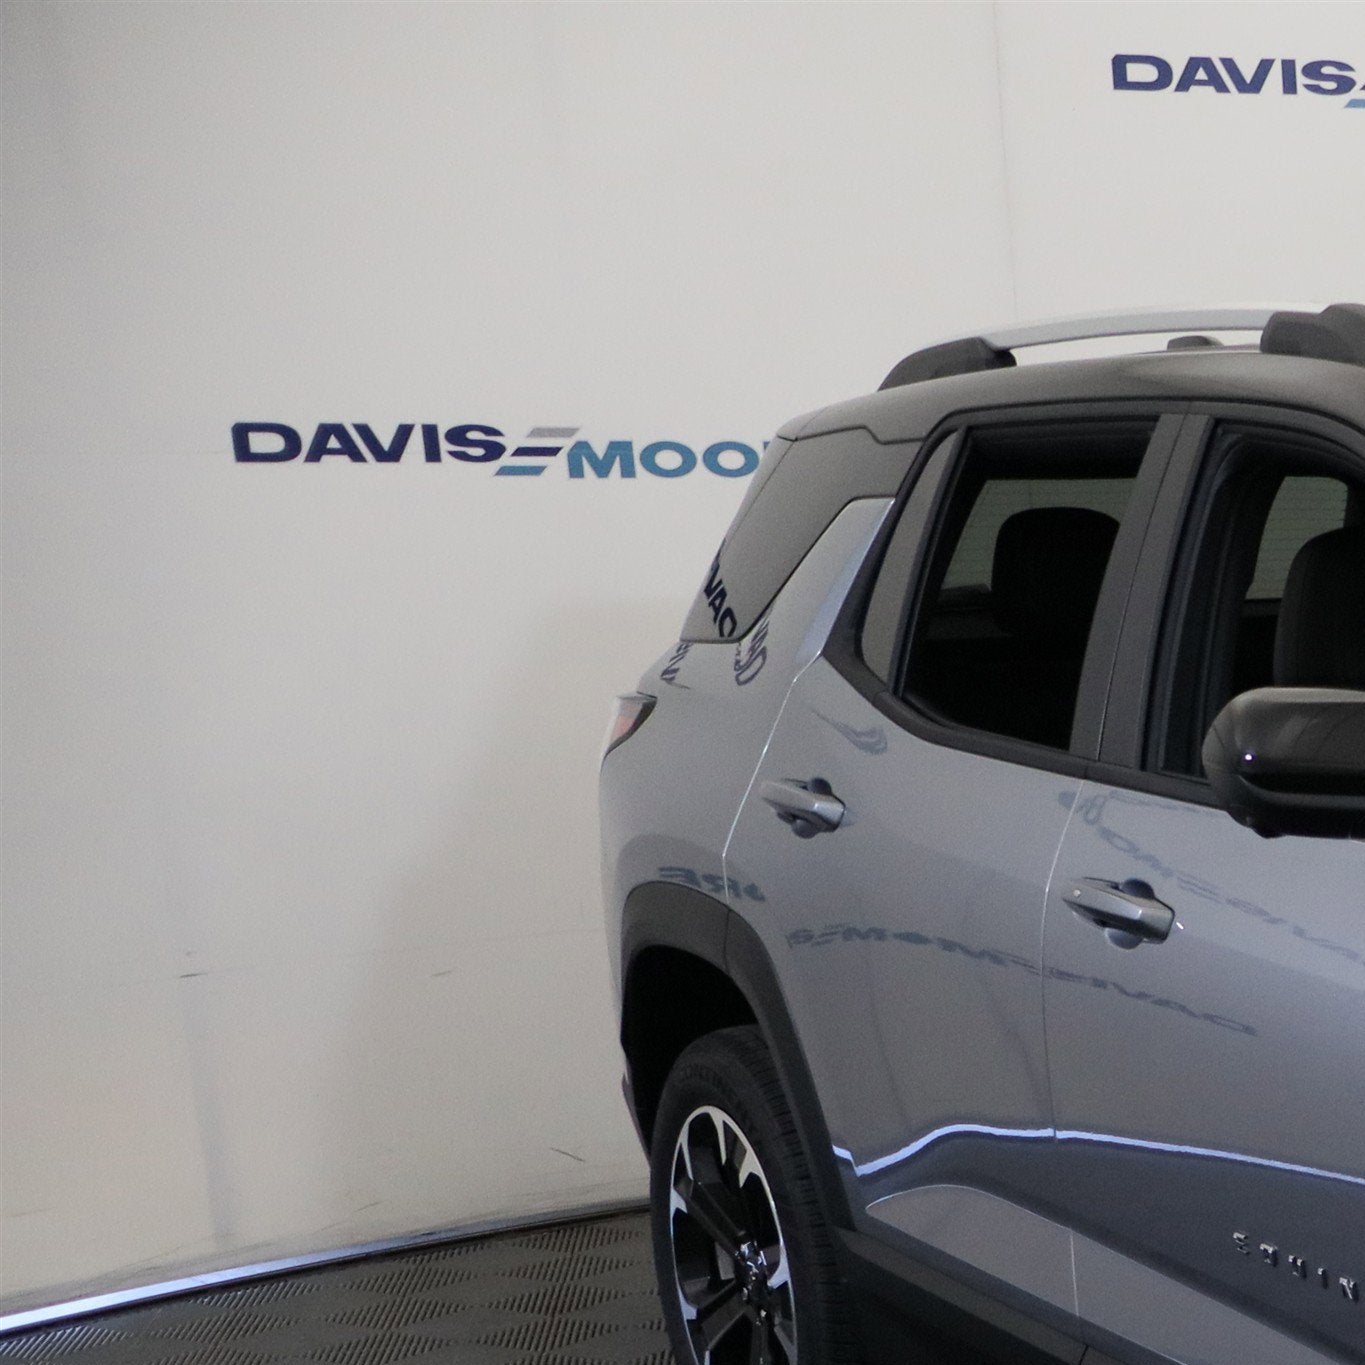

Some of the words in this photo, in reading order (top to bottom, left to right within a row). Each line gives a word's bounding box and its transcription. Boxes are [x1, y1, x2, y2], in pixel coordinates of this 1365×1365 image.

[1111, 53, 1357, 96] DAVIS
[231, 422, 507, 463] DAVIS
[568, 440, 770, 479] MOO
